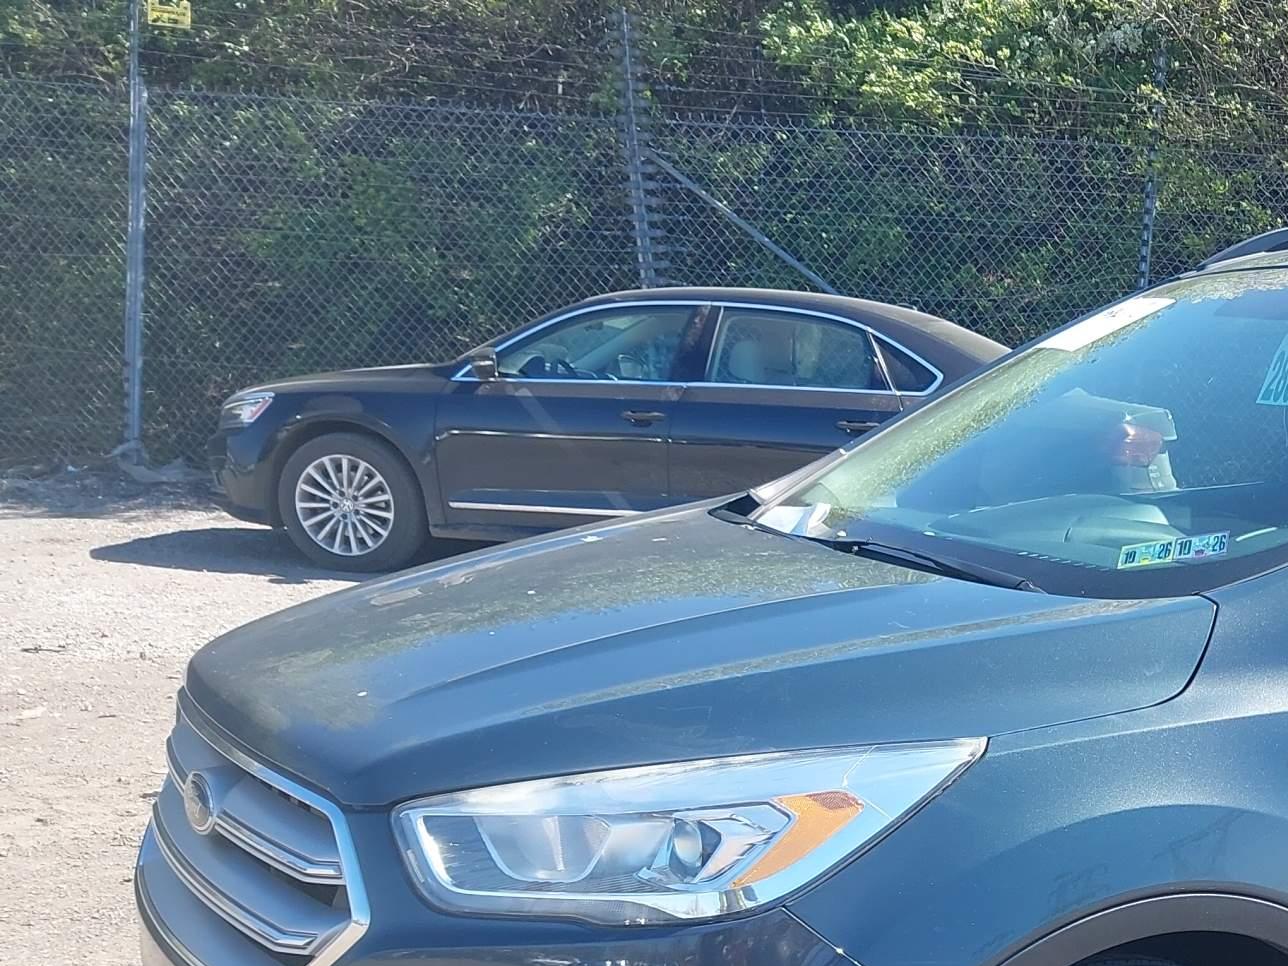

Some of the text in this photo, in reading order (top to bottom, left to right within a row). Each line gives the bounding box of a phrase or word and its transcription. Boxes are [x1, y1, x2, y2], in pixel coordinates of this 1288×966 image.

[1156, 543, 1172, 560] 26
[1179, 535, 1227, 556] 10 26
